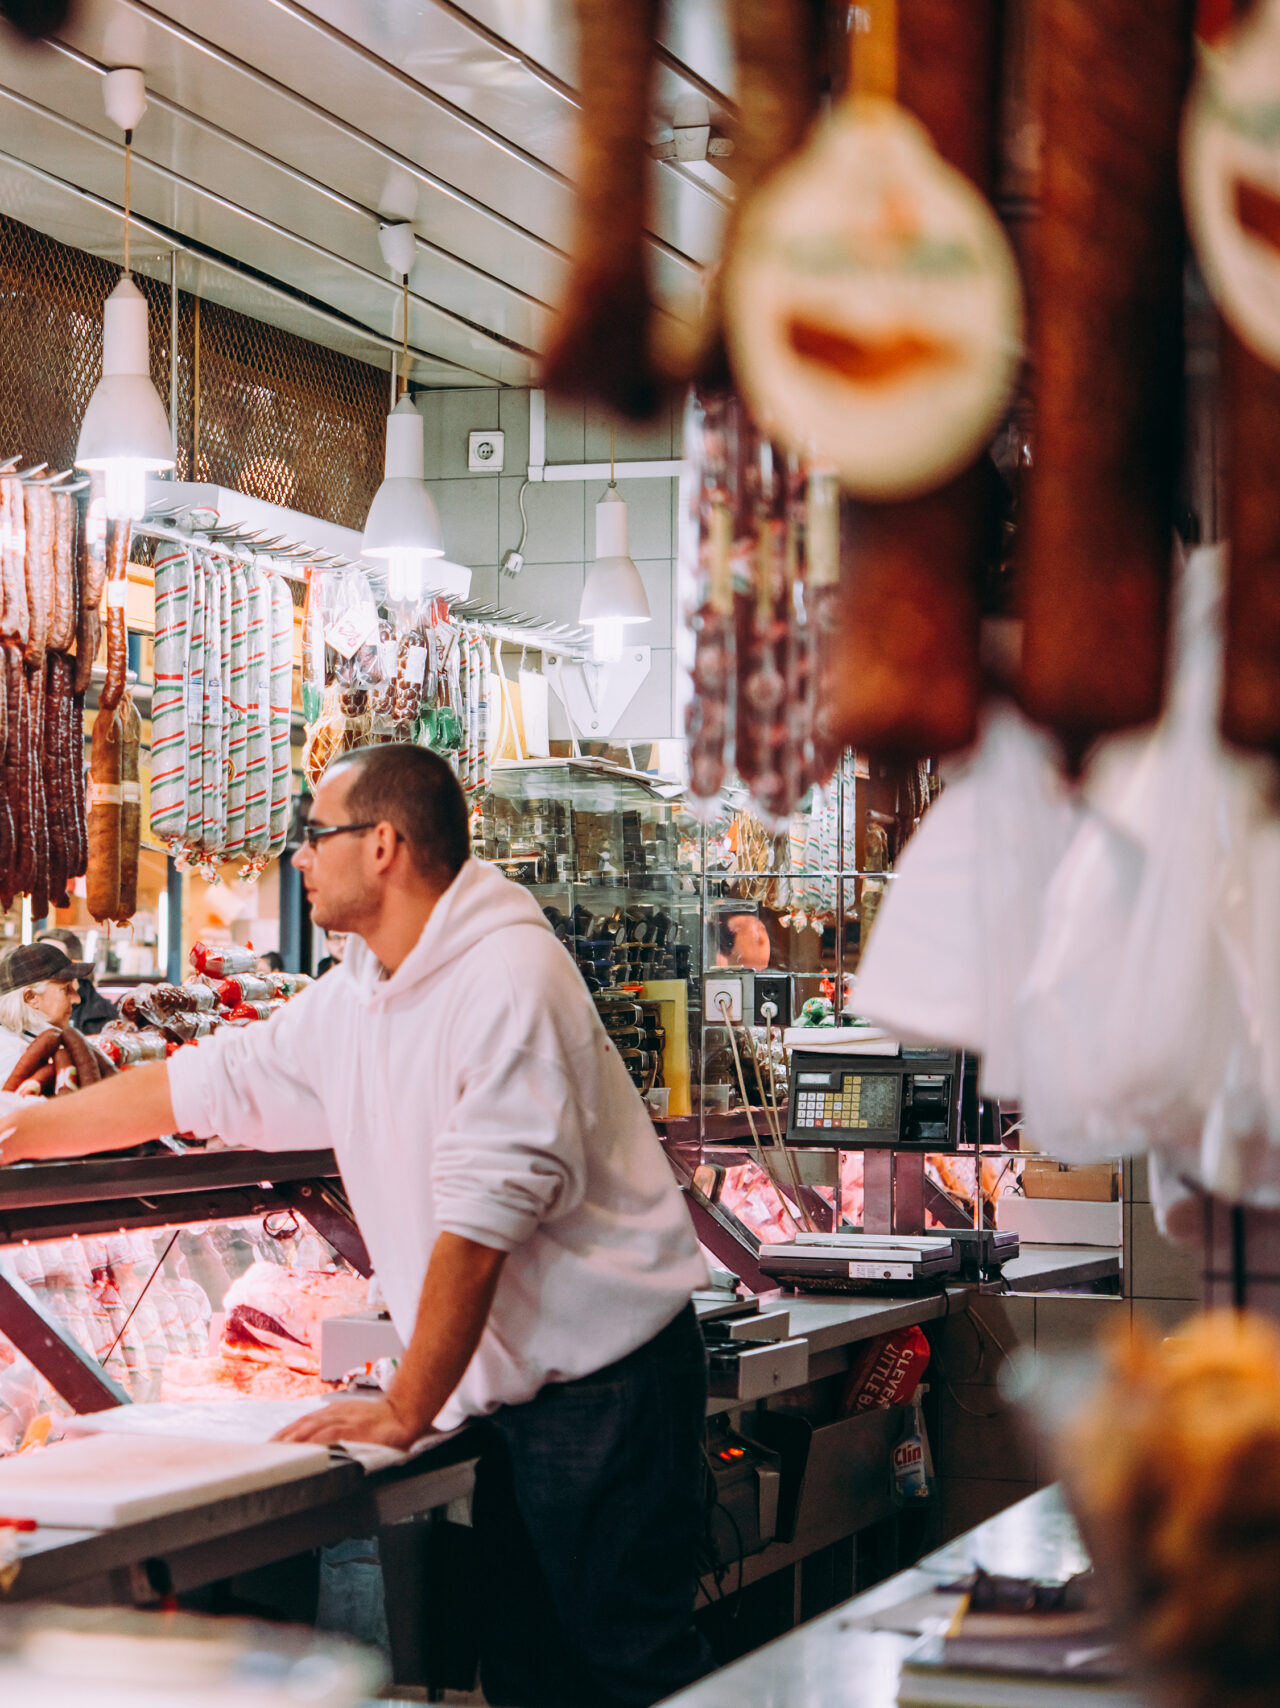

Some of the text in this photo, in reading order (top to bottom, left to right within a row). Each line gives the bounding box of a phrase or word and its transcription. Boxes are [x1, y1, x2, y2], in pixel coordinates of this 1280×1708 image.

[864, 1343, 900, 1394] LITTLE
[877, 1349, 914, 1409] CLEVER
[894, 1443, 922, 1467] Clin
